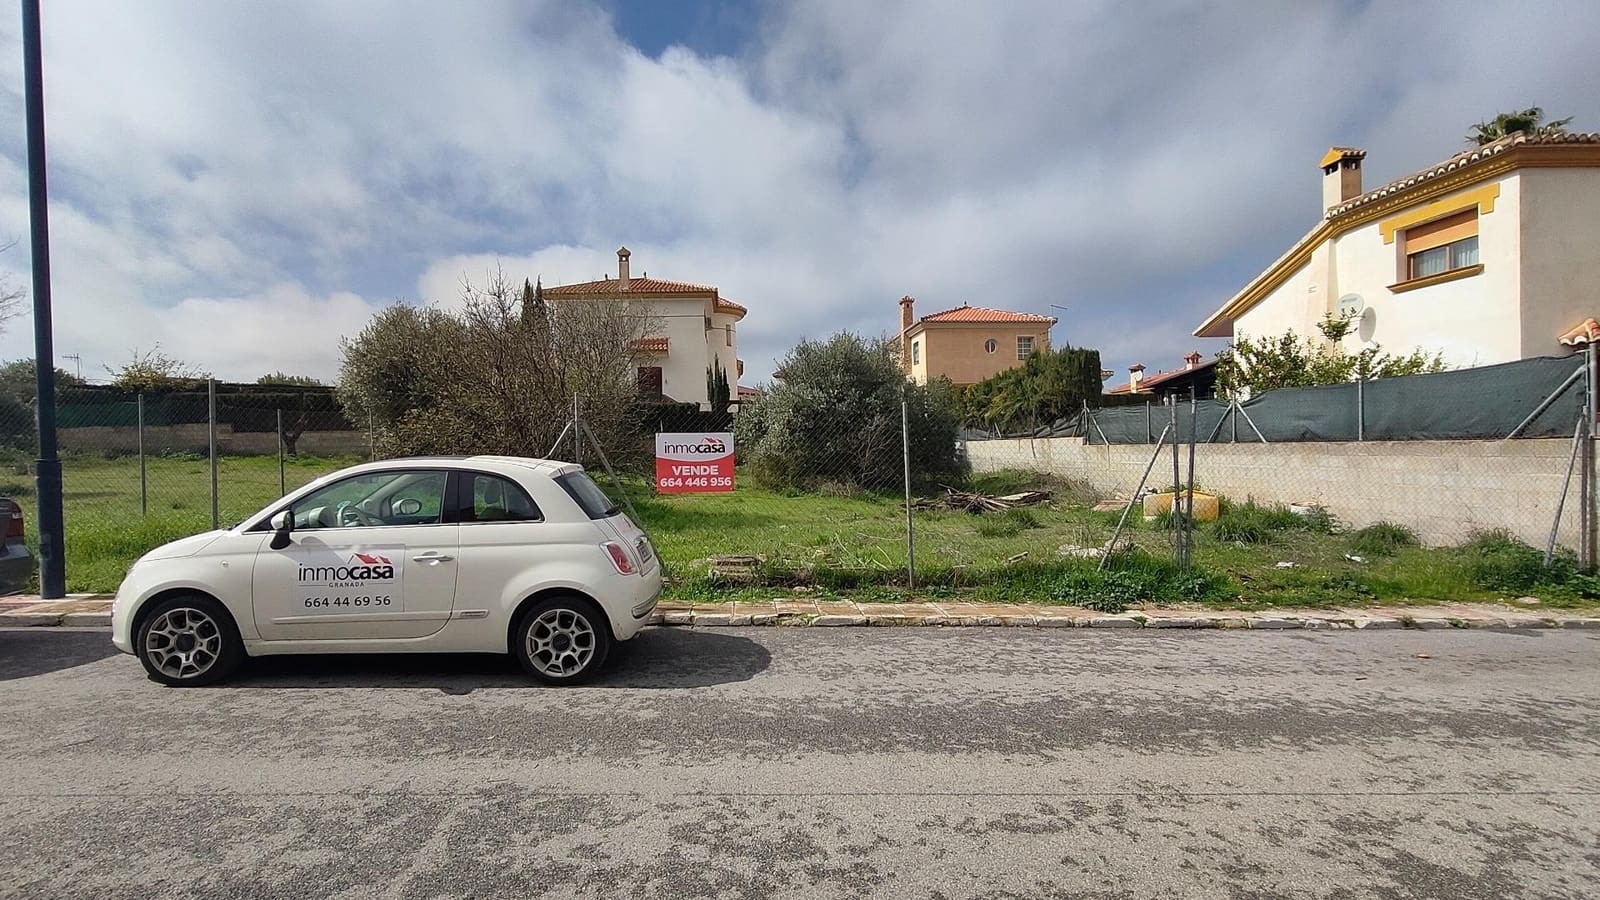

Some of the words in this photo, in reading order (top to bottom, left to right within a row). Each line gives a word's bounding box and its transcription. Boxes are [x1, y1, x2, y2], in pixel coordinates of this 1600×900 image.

[664, 442, 725, 454] inmocasa
[672, 466, 719, 476] VENDE
[660, 478, 682, 487] 664
[685, 478, 708, 486] 446
[710, 477, 732, 486] 956
[298, 563, 394, 581] inmocasa
[304, 597, 329, 608] 664
[334, 597, 350, 607] 44
[354, 596, 370, 606] 69
[375, 596, 391, 606] 56
